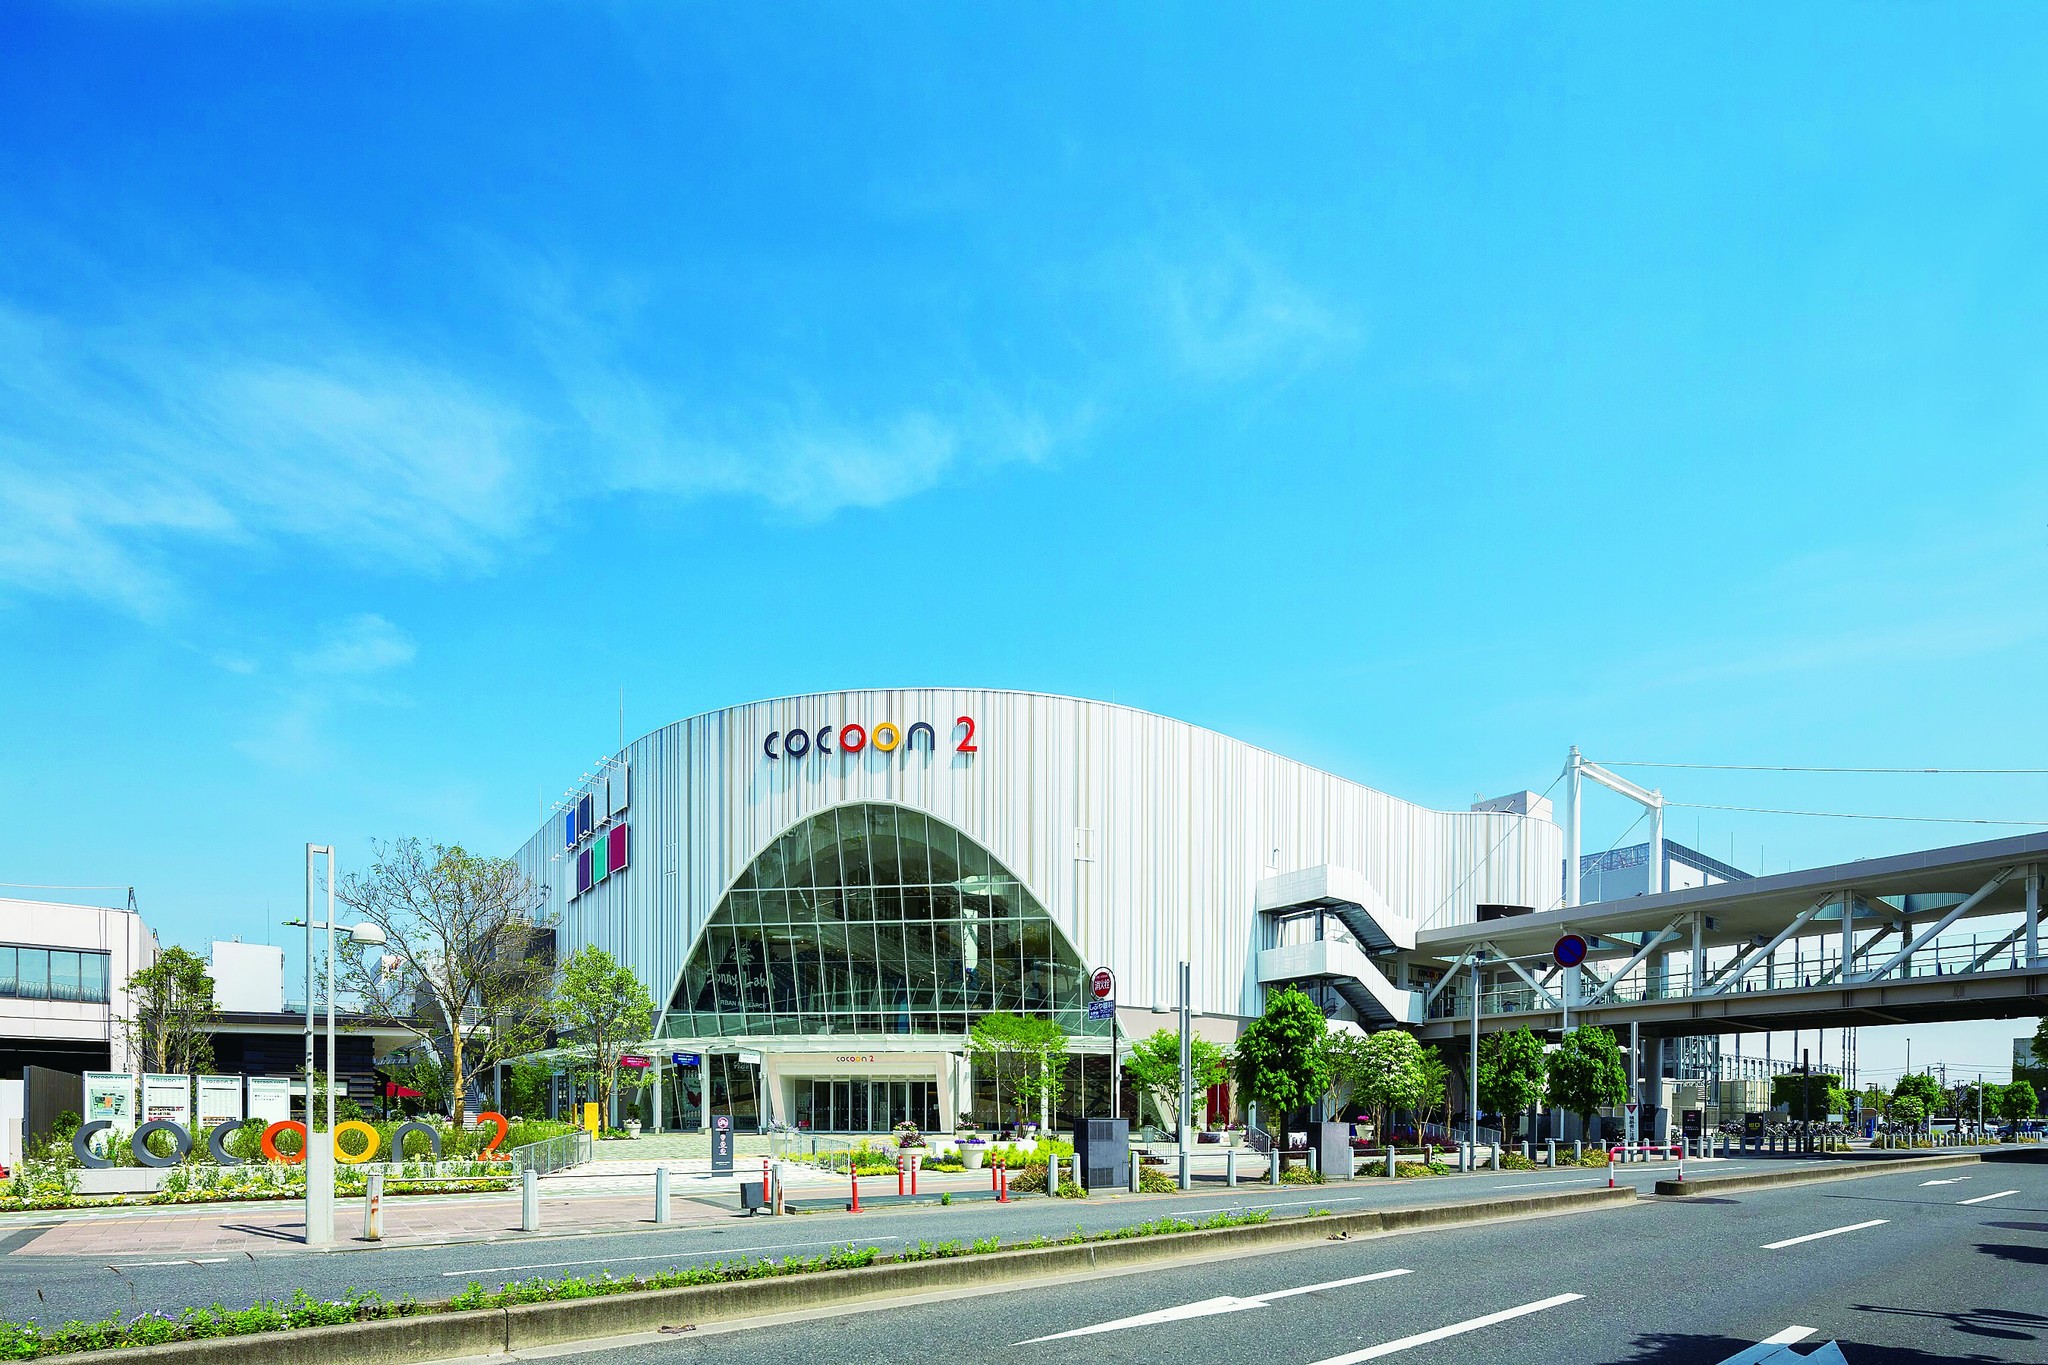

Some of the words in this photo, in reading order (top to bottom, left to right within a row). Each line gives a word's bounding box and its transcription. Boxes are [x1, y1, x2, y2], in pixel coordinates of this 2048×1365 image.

[764, 721, 935, 760] cocoon
[956, 715, 978, 752] 2
[73, 1120, 441, 1168] cocoon
[476, 1111, 510, 1161] 2
